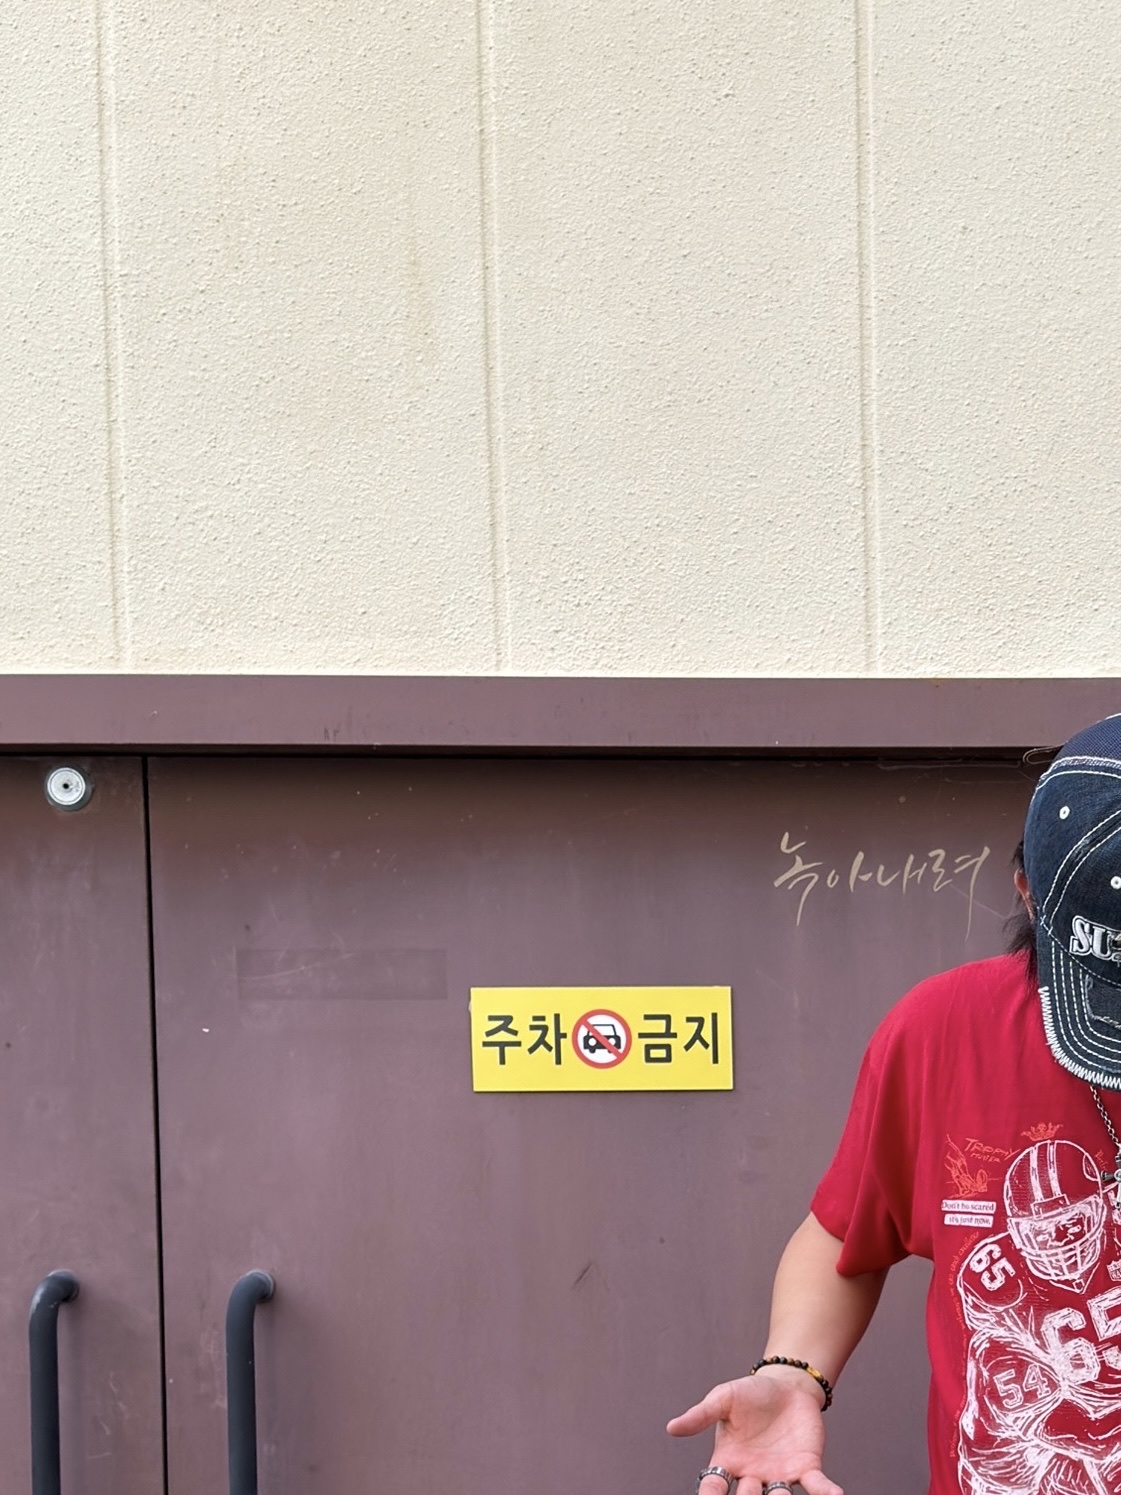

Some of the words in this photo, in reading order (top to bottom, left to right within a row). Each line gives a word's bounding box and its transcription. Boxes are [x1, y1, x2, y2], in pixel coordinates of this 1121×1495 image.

[482, 1013, 567, 1065] 주차
[637, 1013, 719, 1065] 금지
[969, 1243, 1016, 1292] 65
[993, 1364, 1051, 1409] 54
